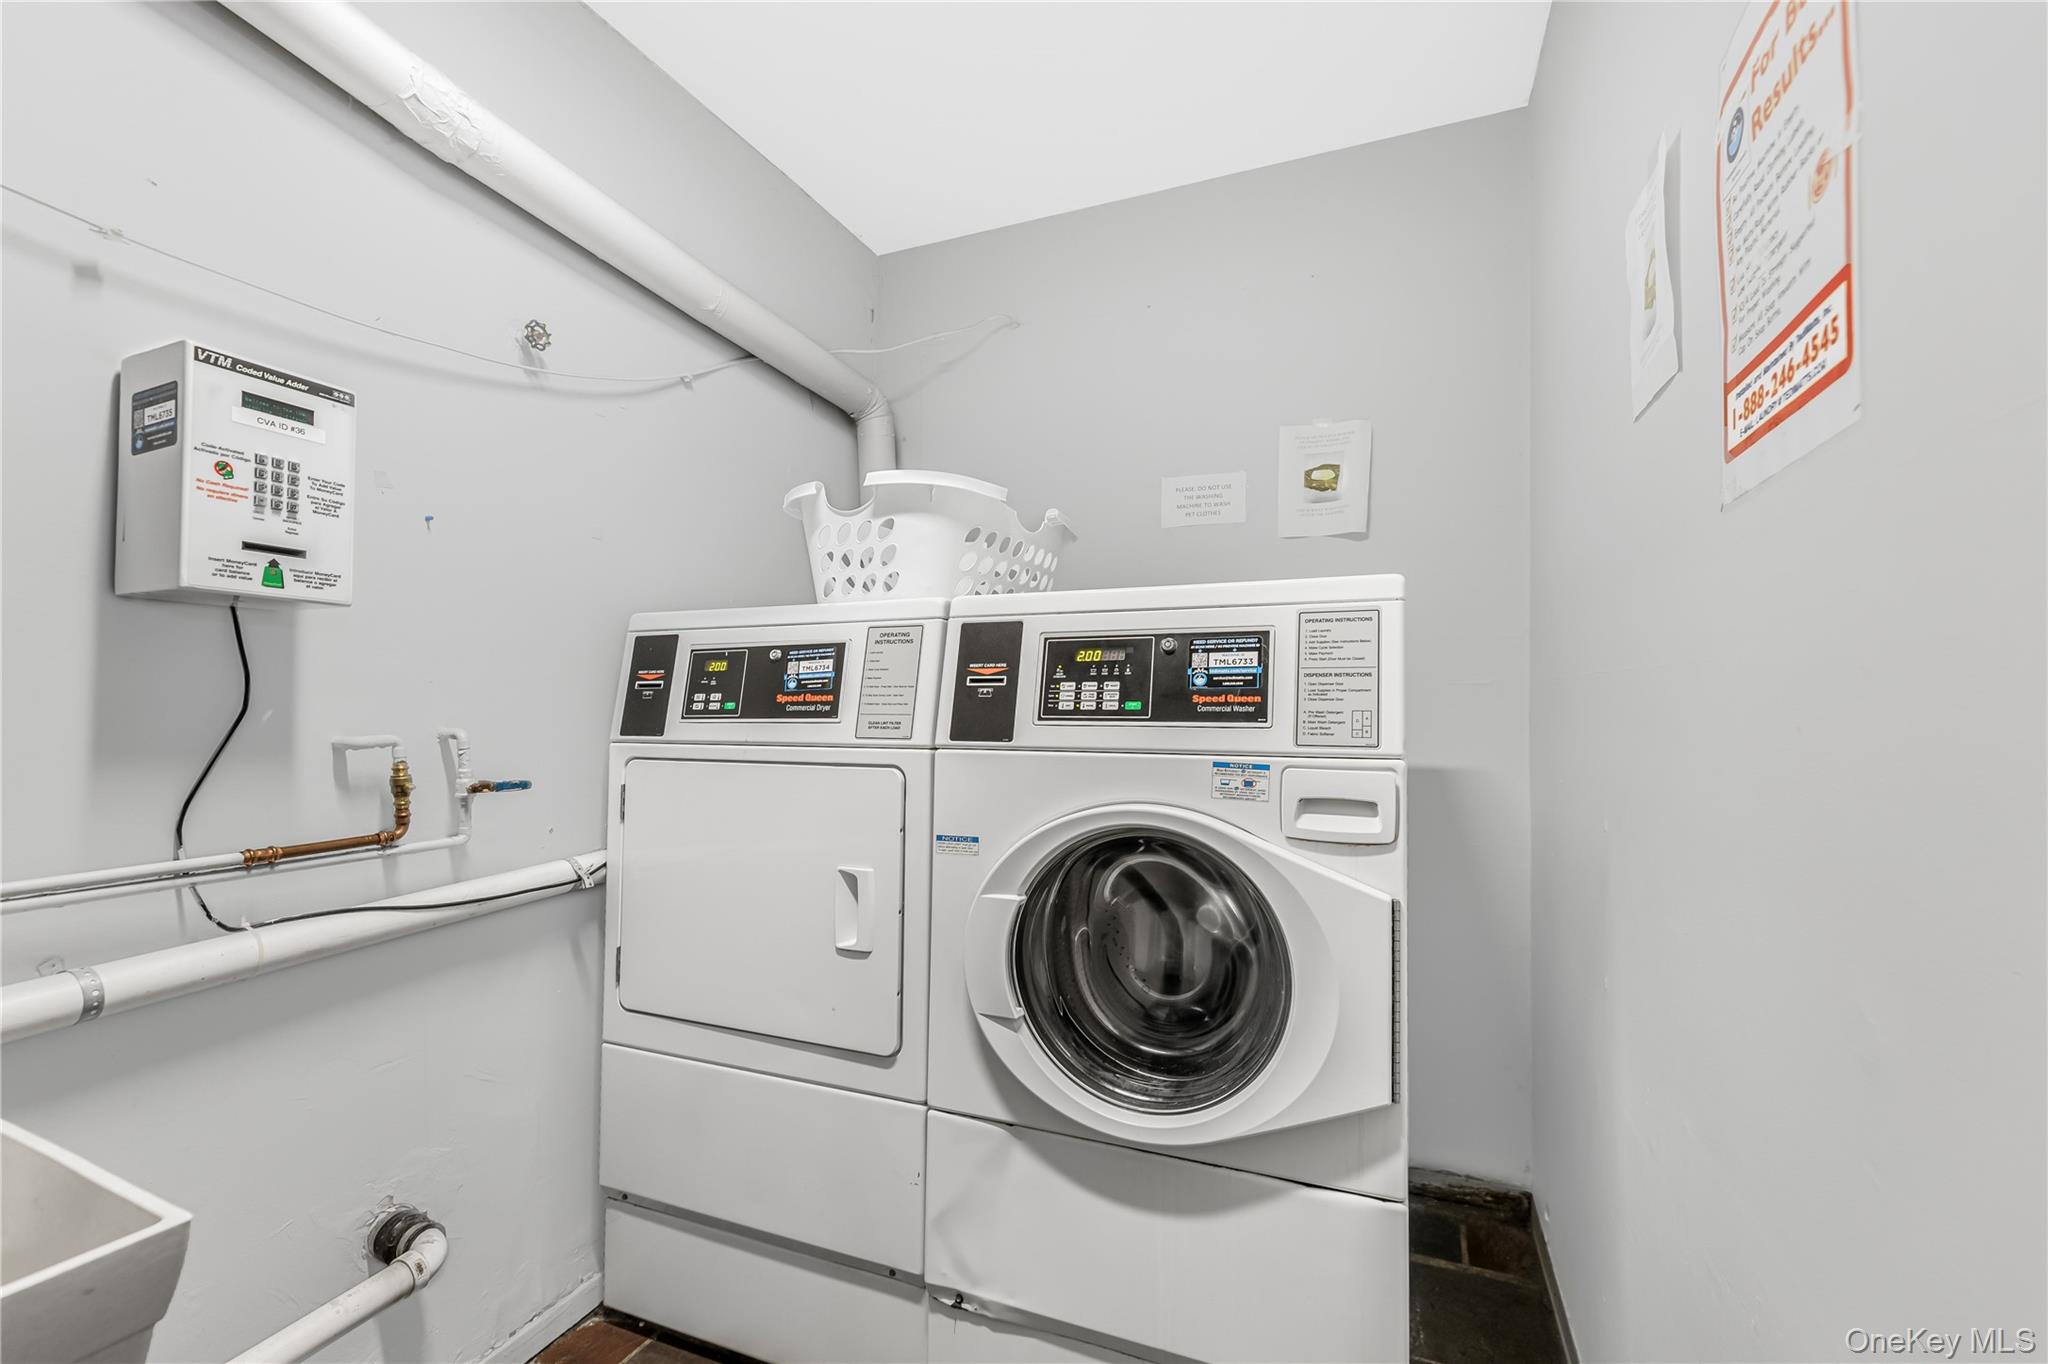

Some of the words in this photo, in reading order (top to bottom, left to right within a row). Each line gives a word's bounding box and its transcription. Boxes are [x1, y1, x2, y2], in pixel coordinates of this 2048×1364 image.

[1751, 28, 1780, 94] For
[197, 349, 232, 369] VTM
[236, 364, 263, 378] Coded
[264, 372, 285, 384] Value
[286, 379, 309, 391] Adder
[1733, 314, 1838, 430] 1-888-246-4545
[256, 417, 276, 428] CVA
[279, 422, 289, 431] ID
[290, 425, 306, 435] #36
[1076, 650, 1102, 661] 2.00
[776, 694, 804, 704] Speed
[805, 694, 833, 702] Queen
[1192, 694, 1225, 703] Speed
[1227, 694, 1261, 703] Queen
[816, 704, 831, 712] Dryer
